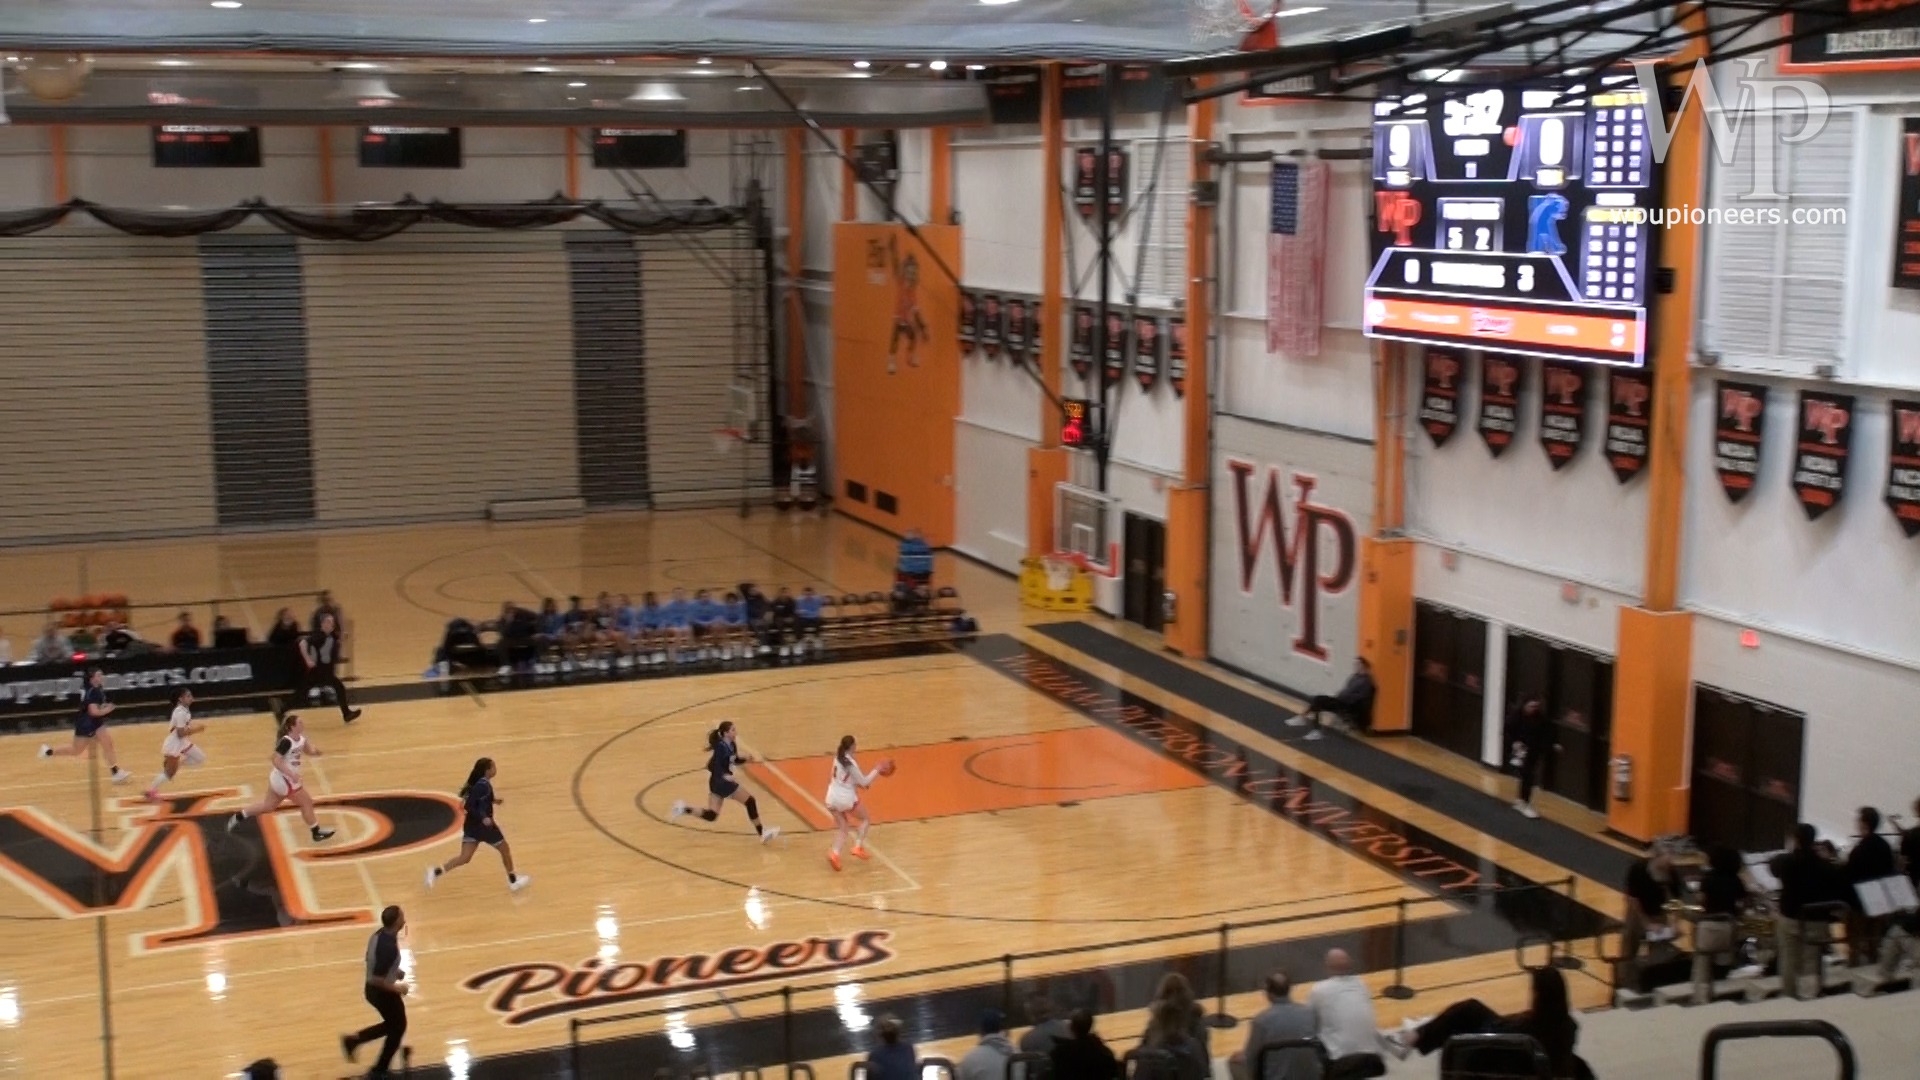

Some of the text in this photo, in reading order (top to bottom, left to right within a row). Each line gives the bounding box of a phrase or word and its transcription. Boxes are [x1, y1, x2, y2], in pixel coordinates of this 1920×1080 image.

[1448, 227, 1463, 249] 5
[1474, 227, 1491, 250] 2
[1516, 265, 1535, 292] 3
[1226, 457, 1357, 662] WP
[1242, 776, 1504, 890] UNIVERSITY
[460, 927, 898, 1027] Pioneers
